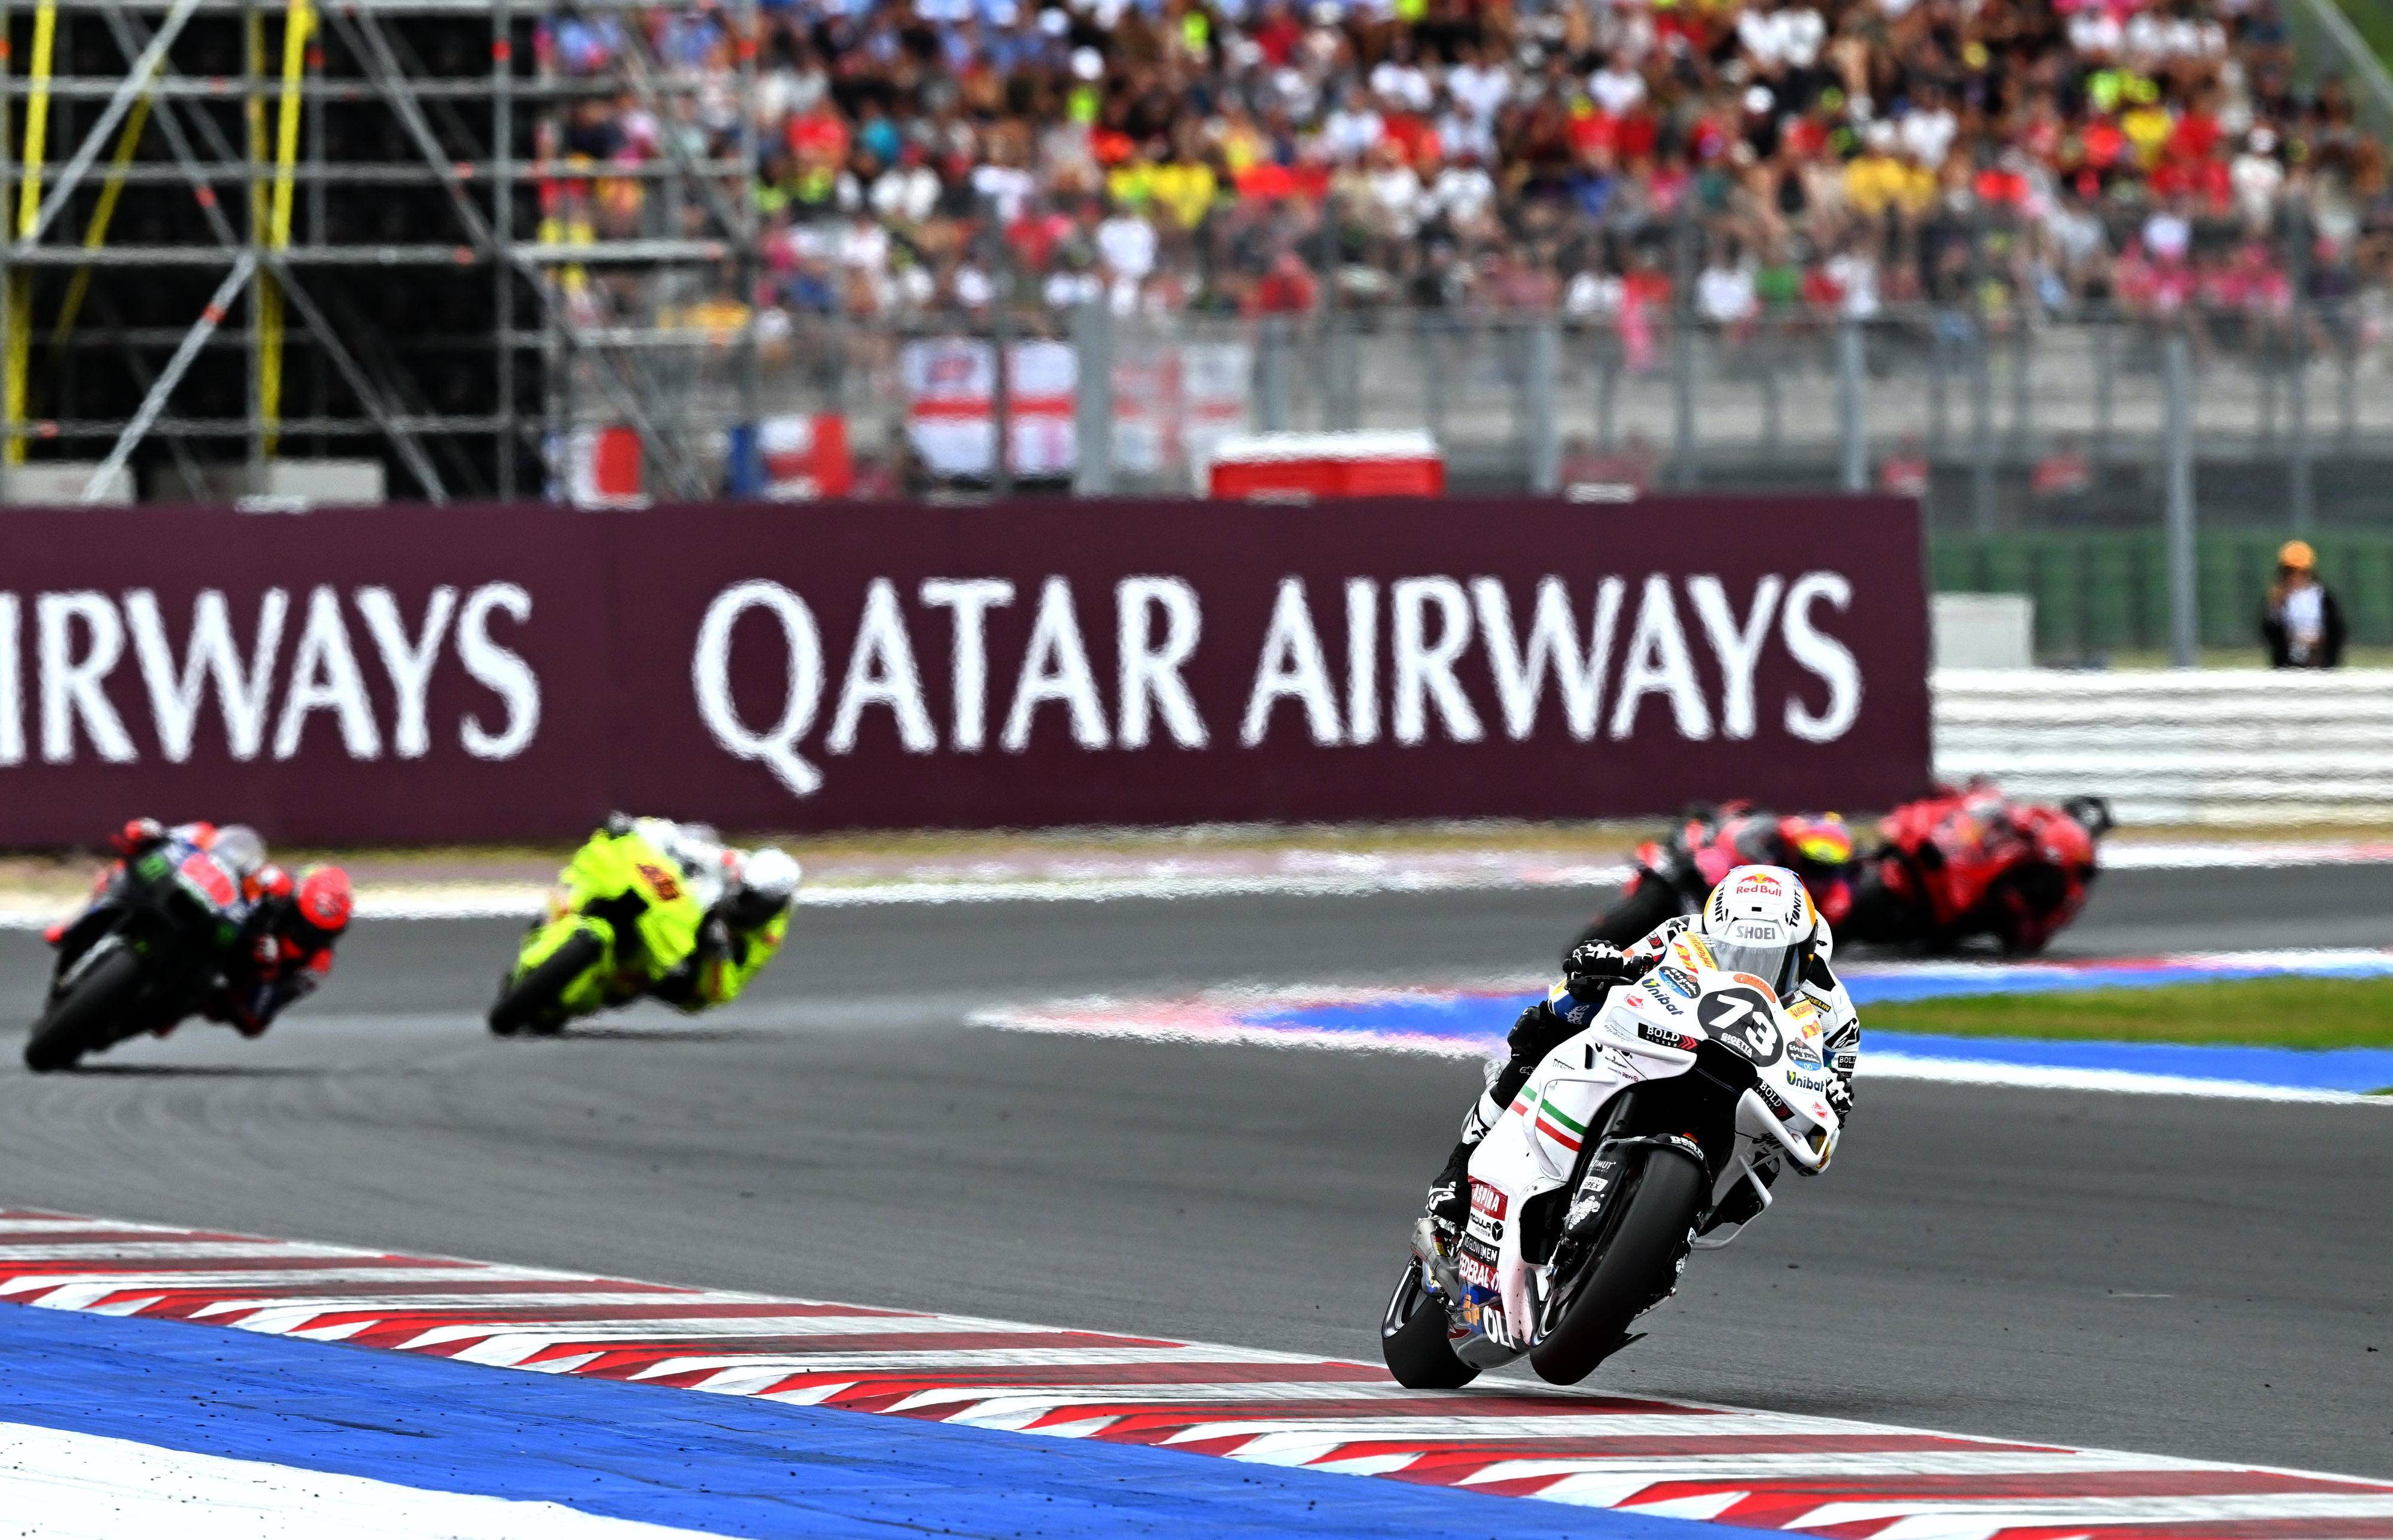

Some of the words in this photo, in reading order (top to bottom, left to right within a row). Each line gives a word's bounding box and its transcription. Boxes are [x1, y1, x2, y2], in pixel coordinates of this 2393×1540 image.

[0, 582, 542, 767] IRWAYS
[692, 576, 1210, 796] QATAR
[1242, 571, 1862, 750] AIRWAYS
[1736, 884, 1758, 894] Red
[1760, 885, 1782, 897] Bull
[1736, 926, 1776, 940] SHOEI
[1642, 978, 1684, 1015] Unibat
[1646, 1025, 1680, 1042] BOLD
[1709, 994, 1778, 1056] 73
[1646, 1035, 1677, 1047] RIDERS
[1759, 1081, 1782, 1107] BOLD
[1786, 1070, 1825, 1092] Unibat
[1472, 1183, 1500, 1212] ASPIRA
[1459, 1252, 1489, 1290] FEDERAL
